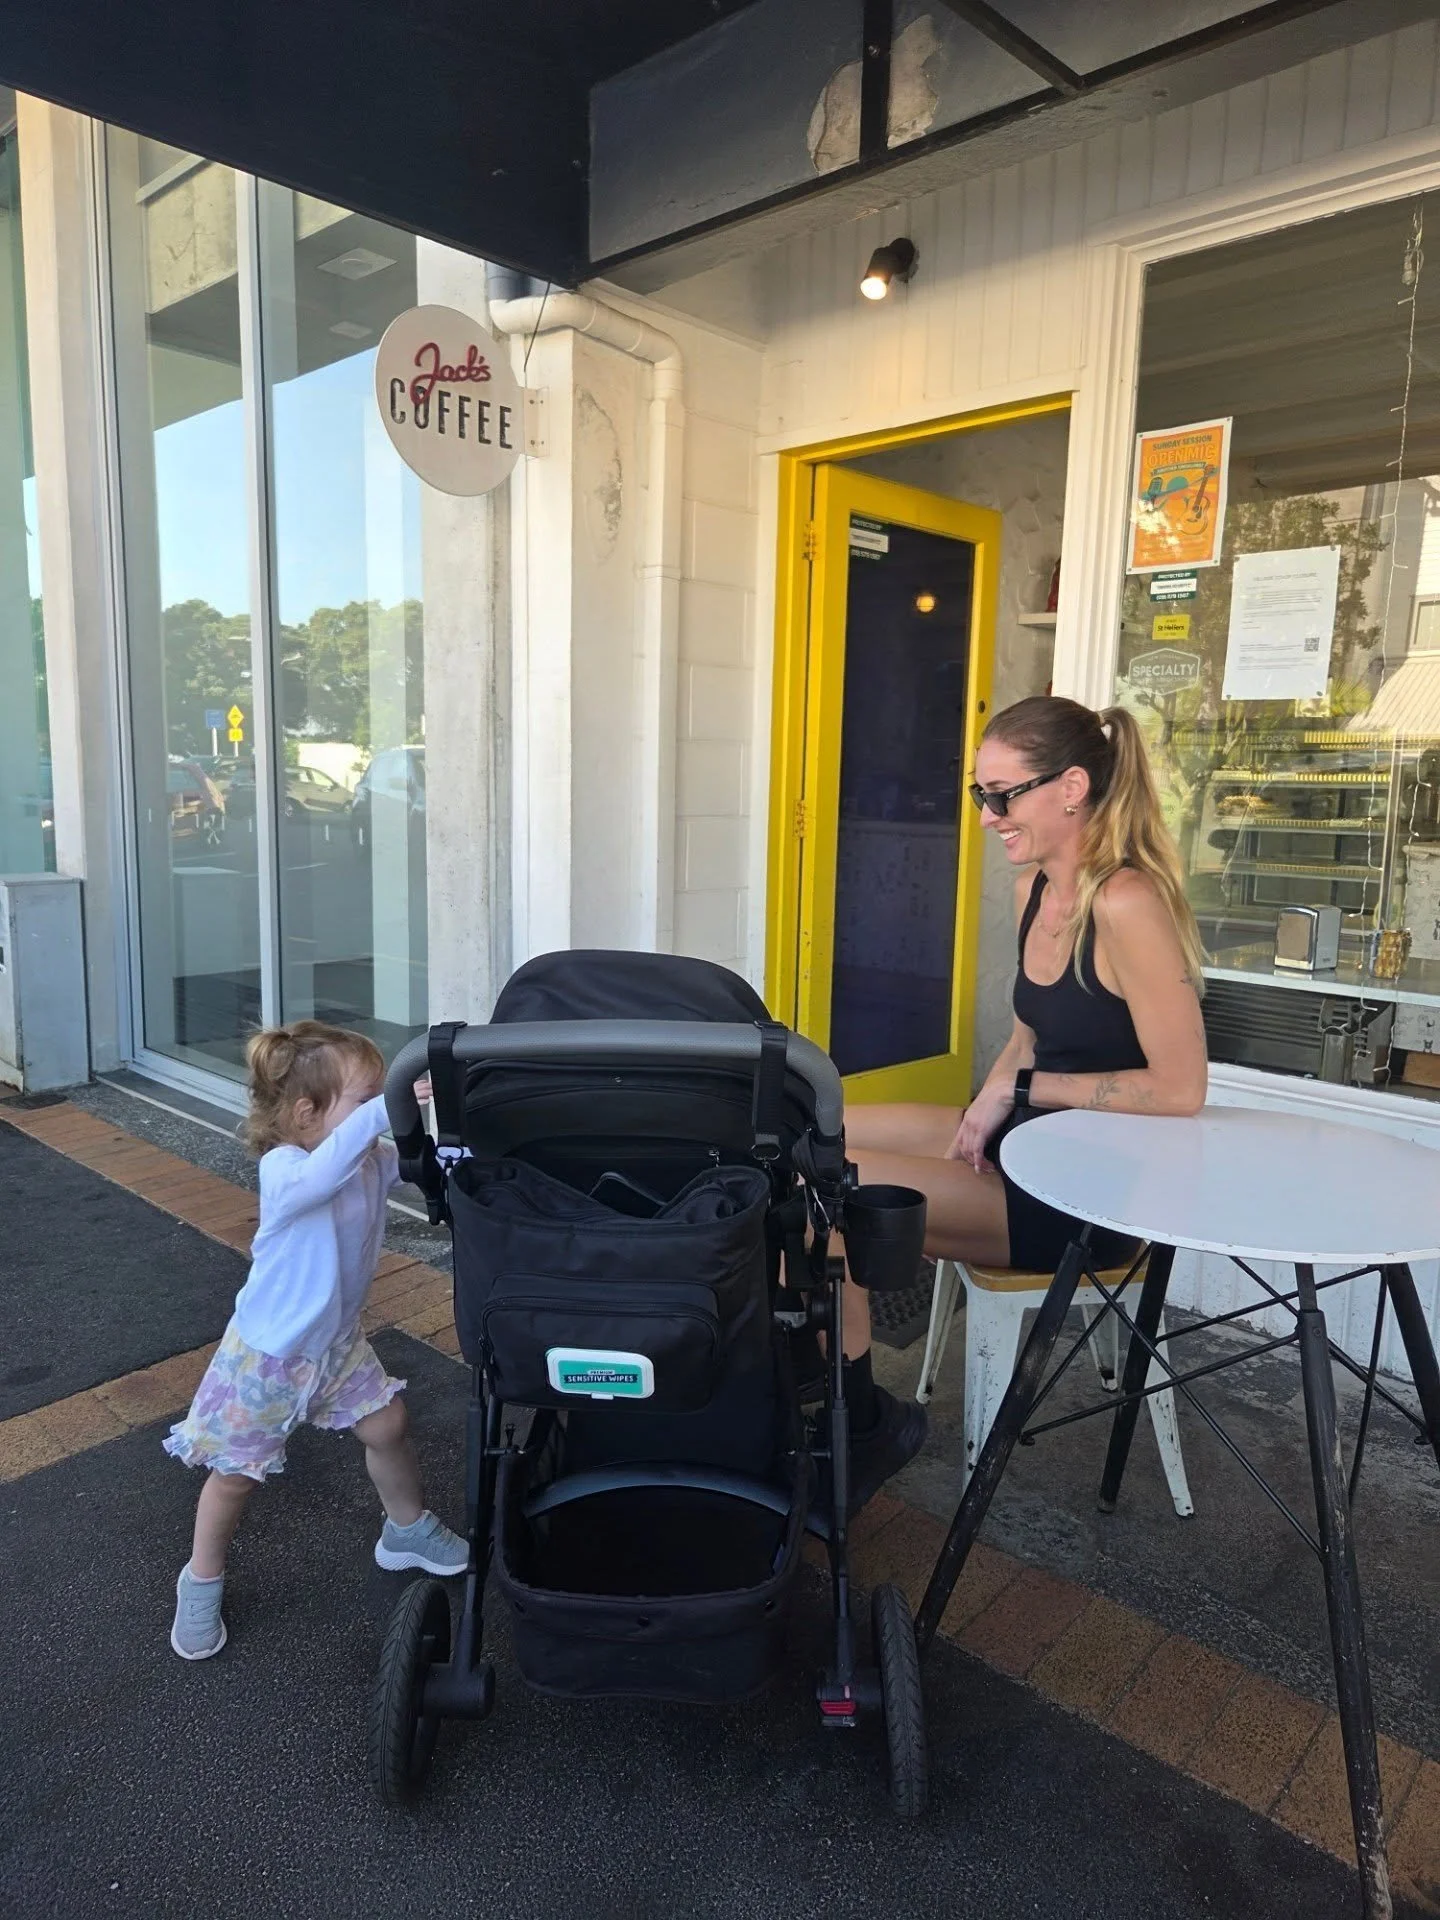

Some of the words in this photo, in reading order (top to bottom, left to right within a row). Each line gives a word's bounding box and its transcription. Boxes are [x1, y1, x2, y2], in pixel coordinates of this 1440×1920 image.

[410, 342, 492, 405] Jack's
[390, 377, 513, 449] COFFEE
[1152, 439, 1181, 451] SUNDAY
[1183, 434, 1212, 444] SESSION
[1148, 447, 1186, 468] OPEN
[1187, 444, 1216, 461] MIC
[1132, 663, 1195, 677] SPECIALTY
